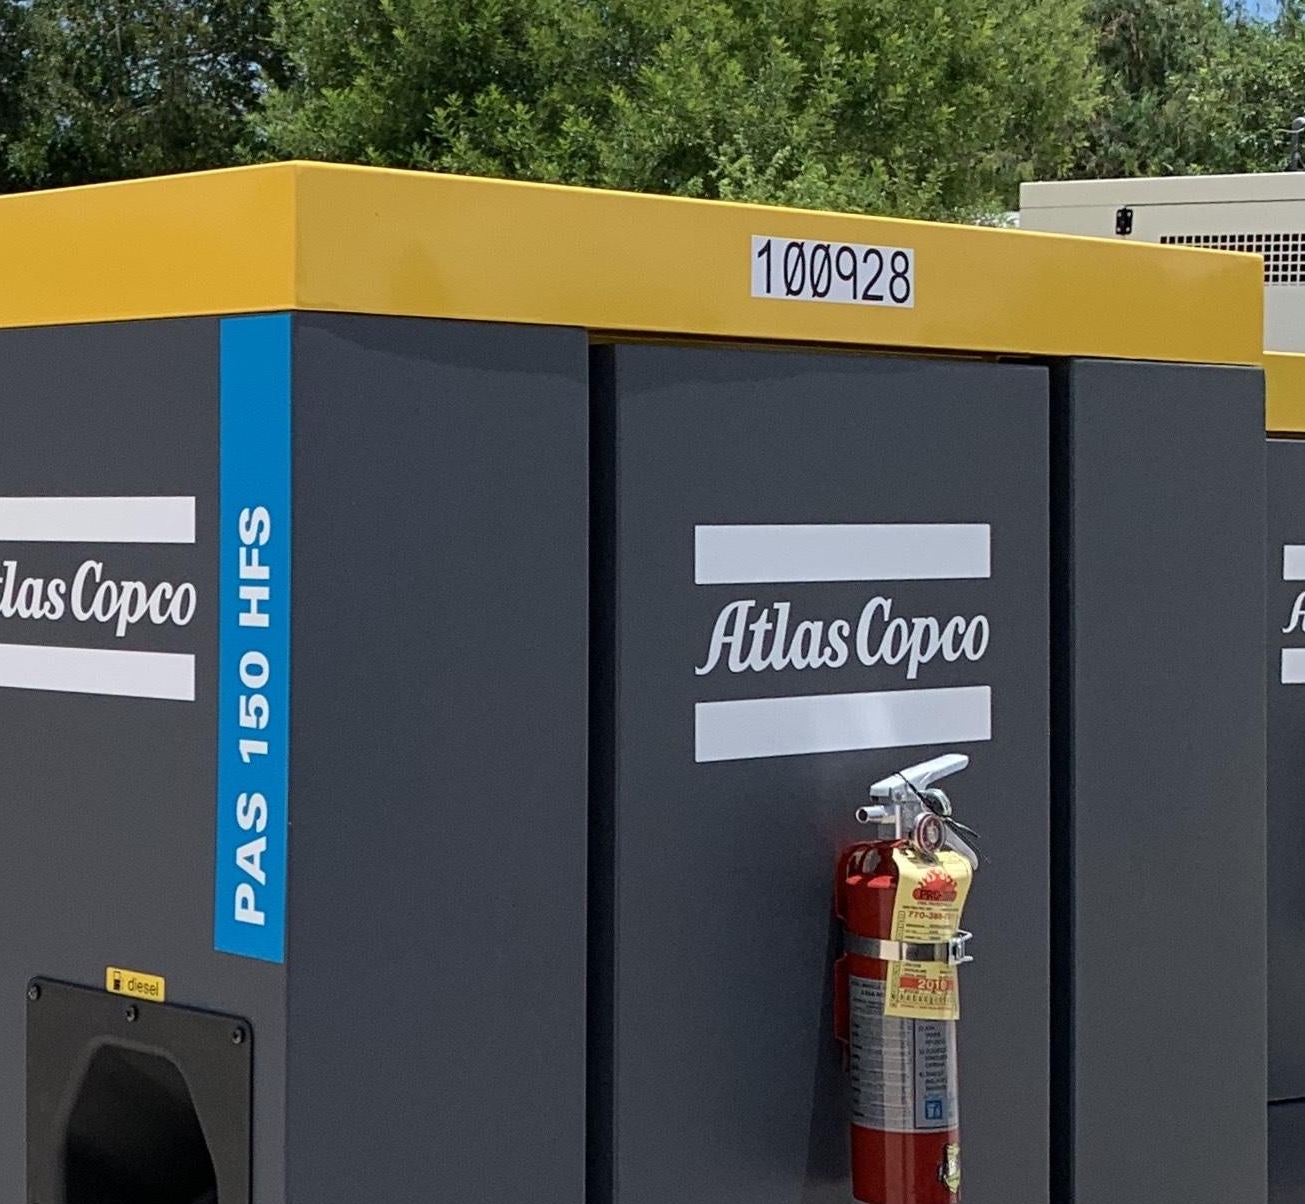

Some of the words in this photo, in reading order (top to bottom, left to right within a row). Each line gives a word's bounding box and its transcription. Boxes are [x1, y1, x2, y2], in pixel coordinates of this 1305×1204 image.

[756, 238, 913, 304] 100928
[71, 559, 196, 637] Copco
[238, 505, 272, 627] HFS
[695, 599, 850, 676] Atlas
[855, 596, 990, 679] Copco
[238, 651, 270, 764] 150
[234, 791, 269, 926] PAS
[127, 978, 159, 996] diesel
